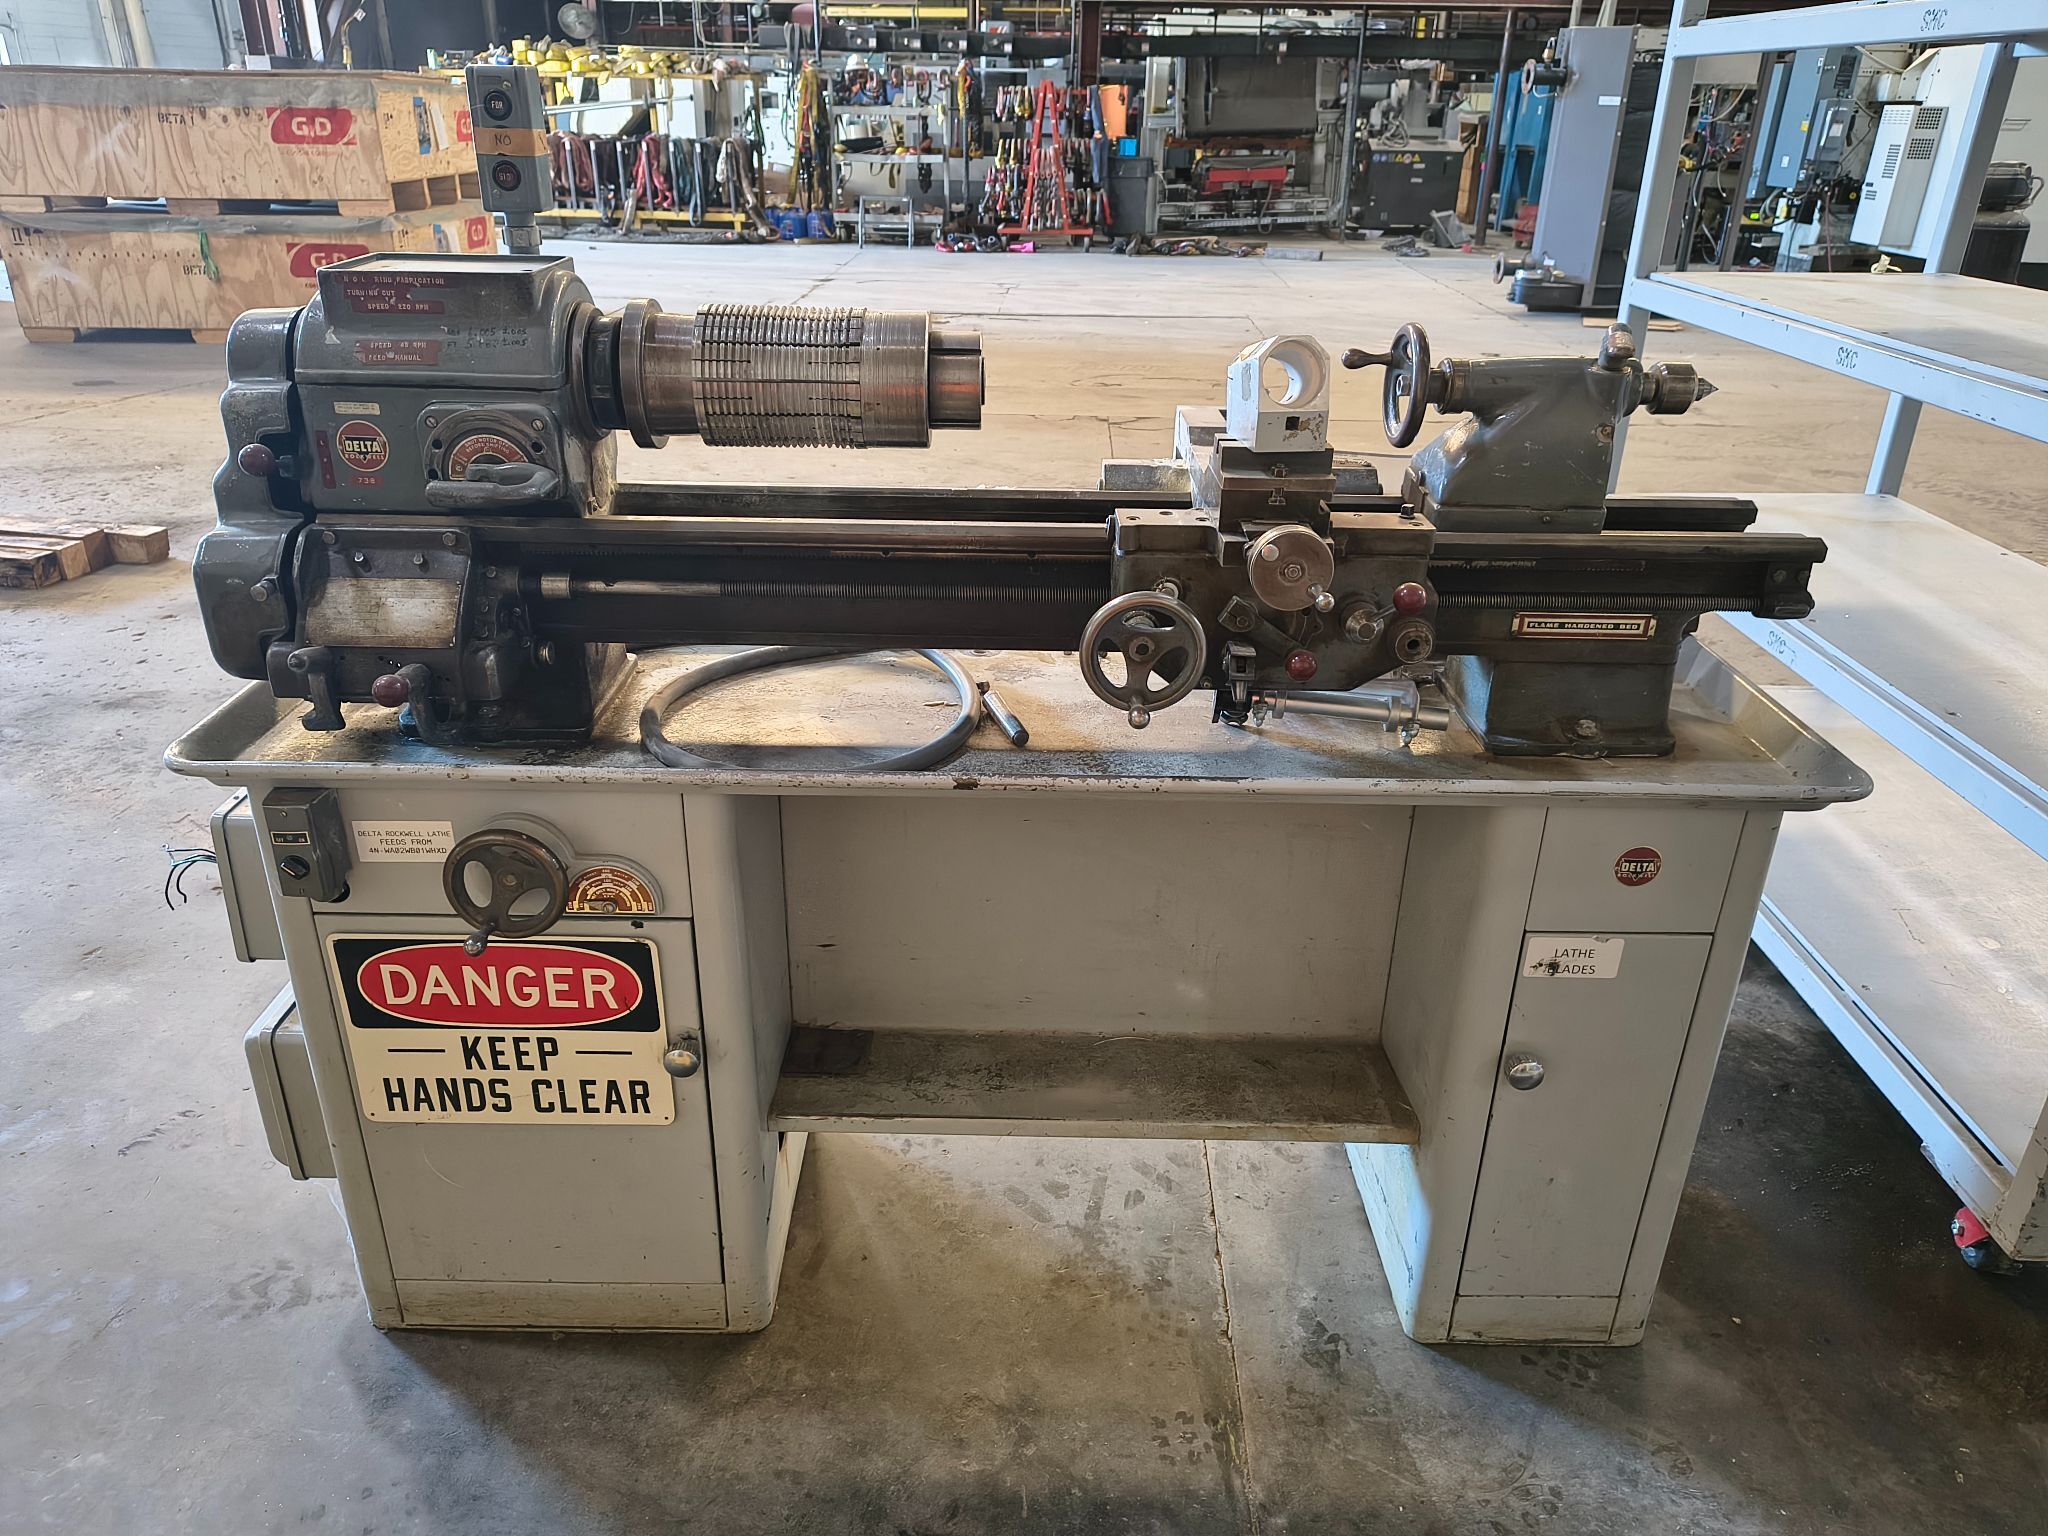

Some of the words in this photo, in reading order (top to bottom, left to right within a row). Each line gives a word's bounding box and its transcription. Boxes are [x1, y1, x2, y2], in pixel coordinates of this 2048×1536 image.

[491, 101, 503, 109] FOR
[158, 112, 186, 126] BETA
[494, 134, 512, 147] NO
[415, 303, 429, 311] RPM
[344, 440, 382, 452] DELTA
[380, 838, 407, 846] FEEDS
[411, 838, 433, 846] FROM
[1621, 863, 1655, 872] DELTA
[1554, 948, 1596, 959] LATHE
[379, 964, 619, 1010] DANGER
[460, 1036, 559, 1071] KEEP
[383, 1077, 512, 1113] HANDS
[531, 1079, 651, 1114] CLEAR
